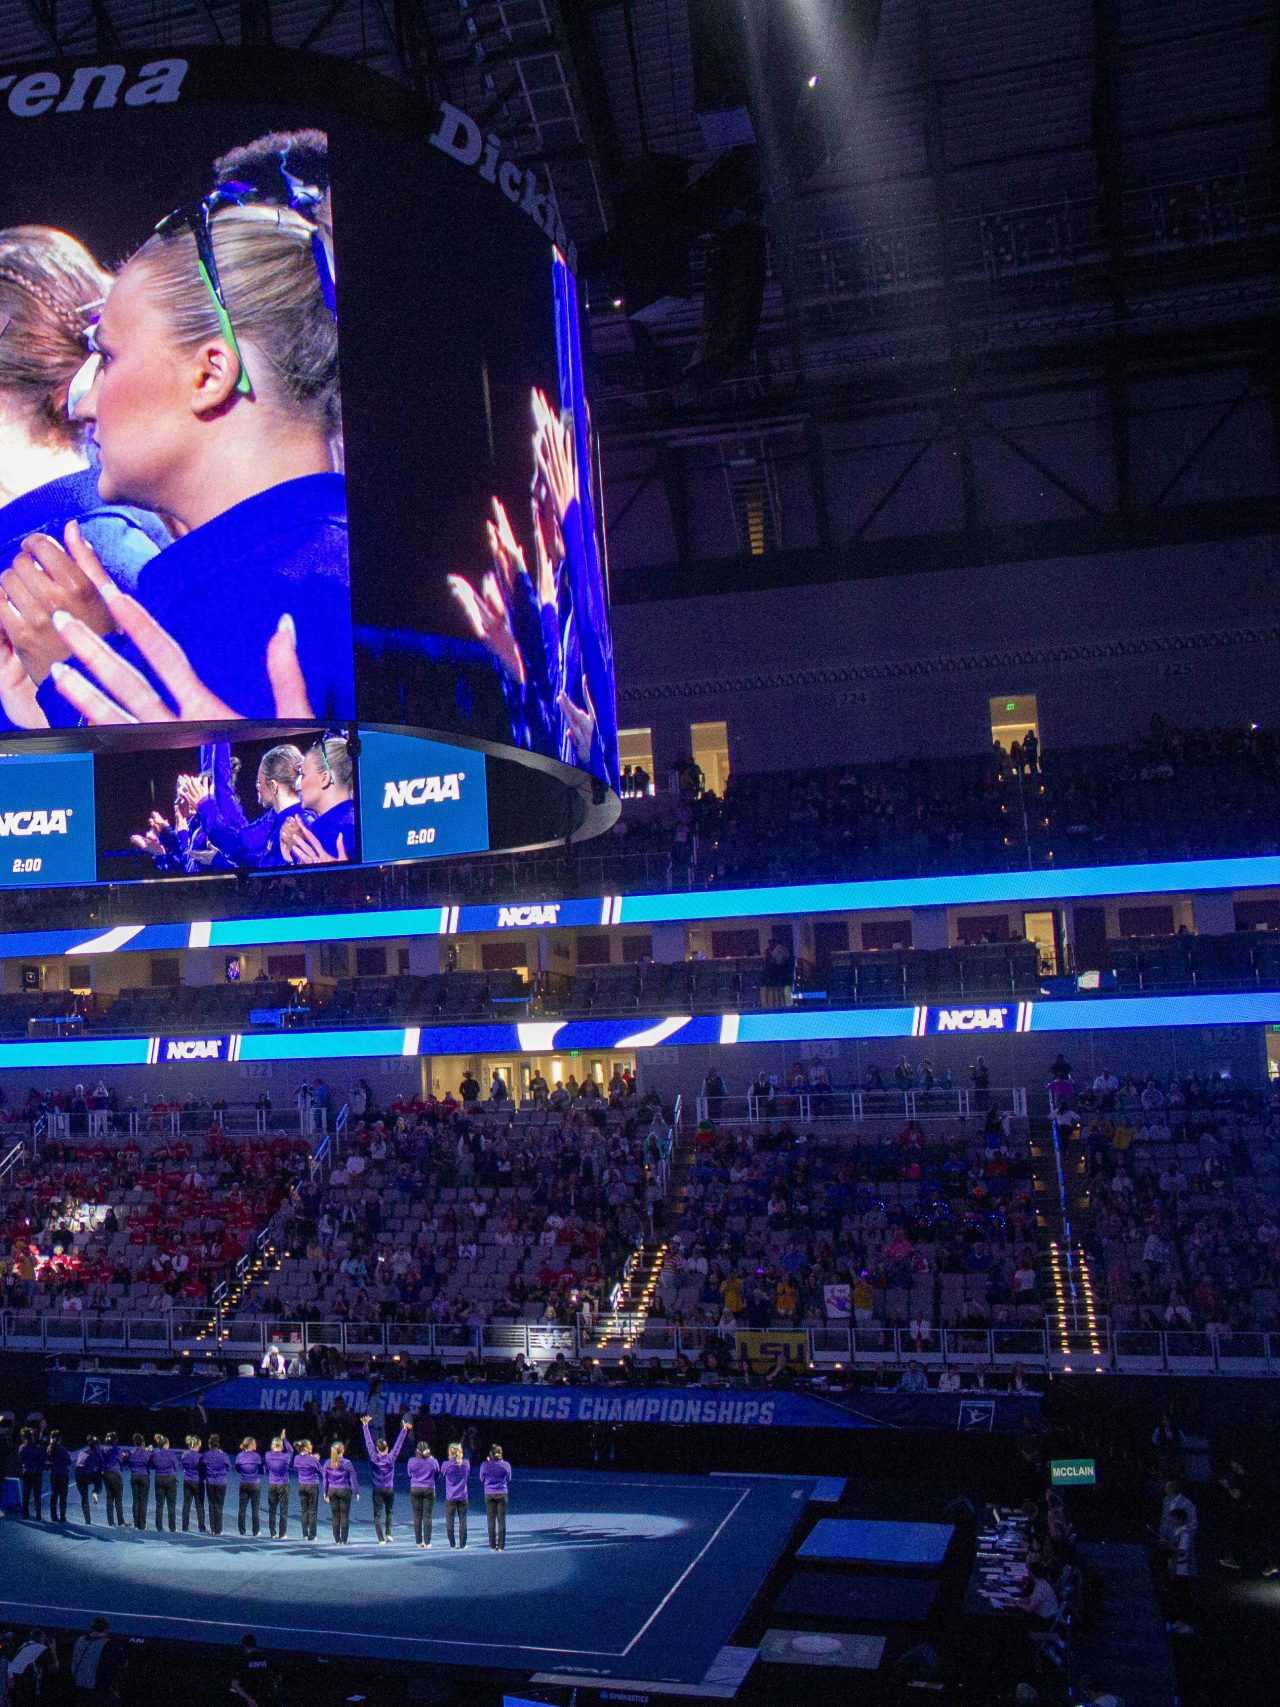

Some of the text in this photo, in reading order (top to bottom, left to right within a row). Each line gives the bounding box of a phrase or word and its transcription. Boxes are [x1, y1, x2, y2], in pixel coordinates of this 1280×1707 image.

[407, 828, 435, 845] 2:00
[12, 858, 42, 873] 2:00
[740, 1343, 805, 1364] LSU
[260, 1388, 313, 1410] NCAA
[429, 1393, 571, 1419] GYMNASTICS
[578, 1397, 776, 1424] CHAMPIONSHIPS
[1052, 1466, 1094, 1477] MCCLAIN
